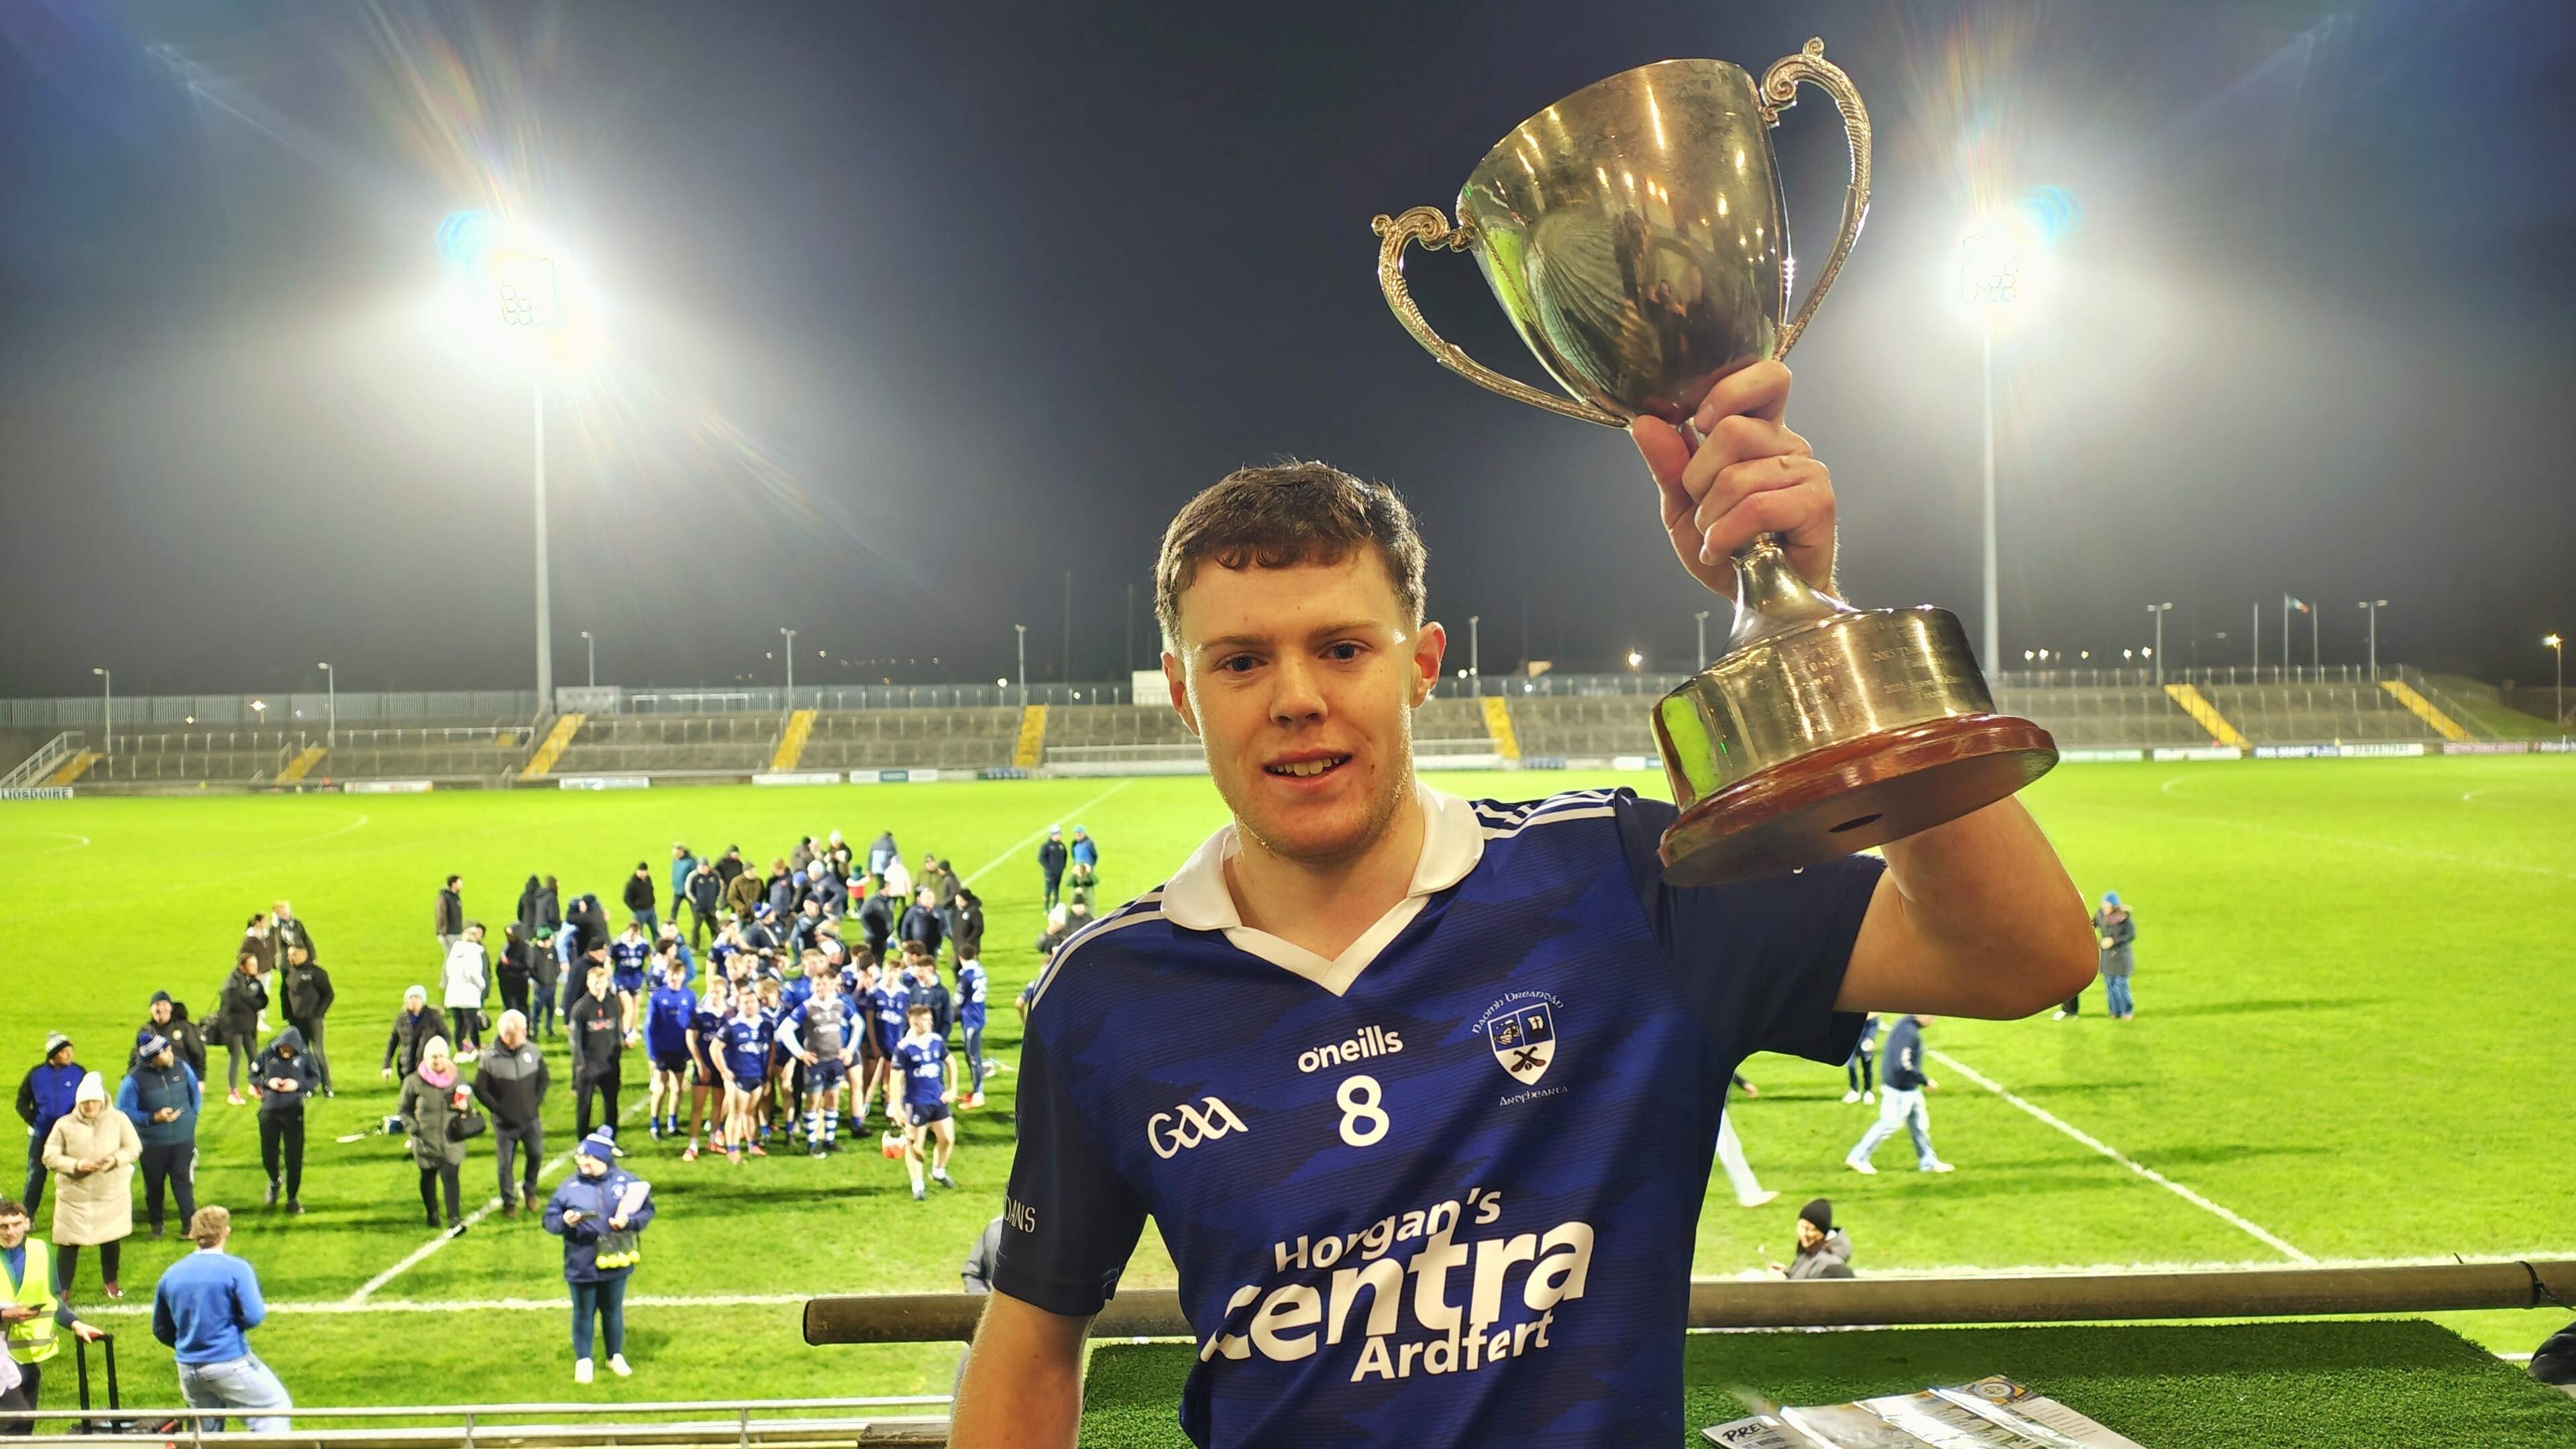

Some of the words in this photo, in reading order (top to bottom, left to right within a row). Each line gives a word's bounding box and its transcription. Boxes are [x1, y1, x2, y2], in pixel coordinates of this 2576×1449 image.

[1148, 1096, 1249, 1159] GAA
[1336, 1075, 1390, 1146] 8
[1275, 1187, 1501, 1273] Horgan's
[1350, 1309, 1554, 1383] Ardfert
